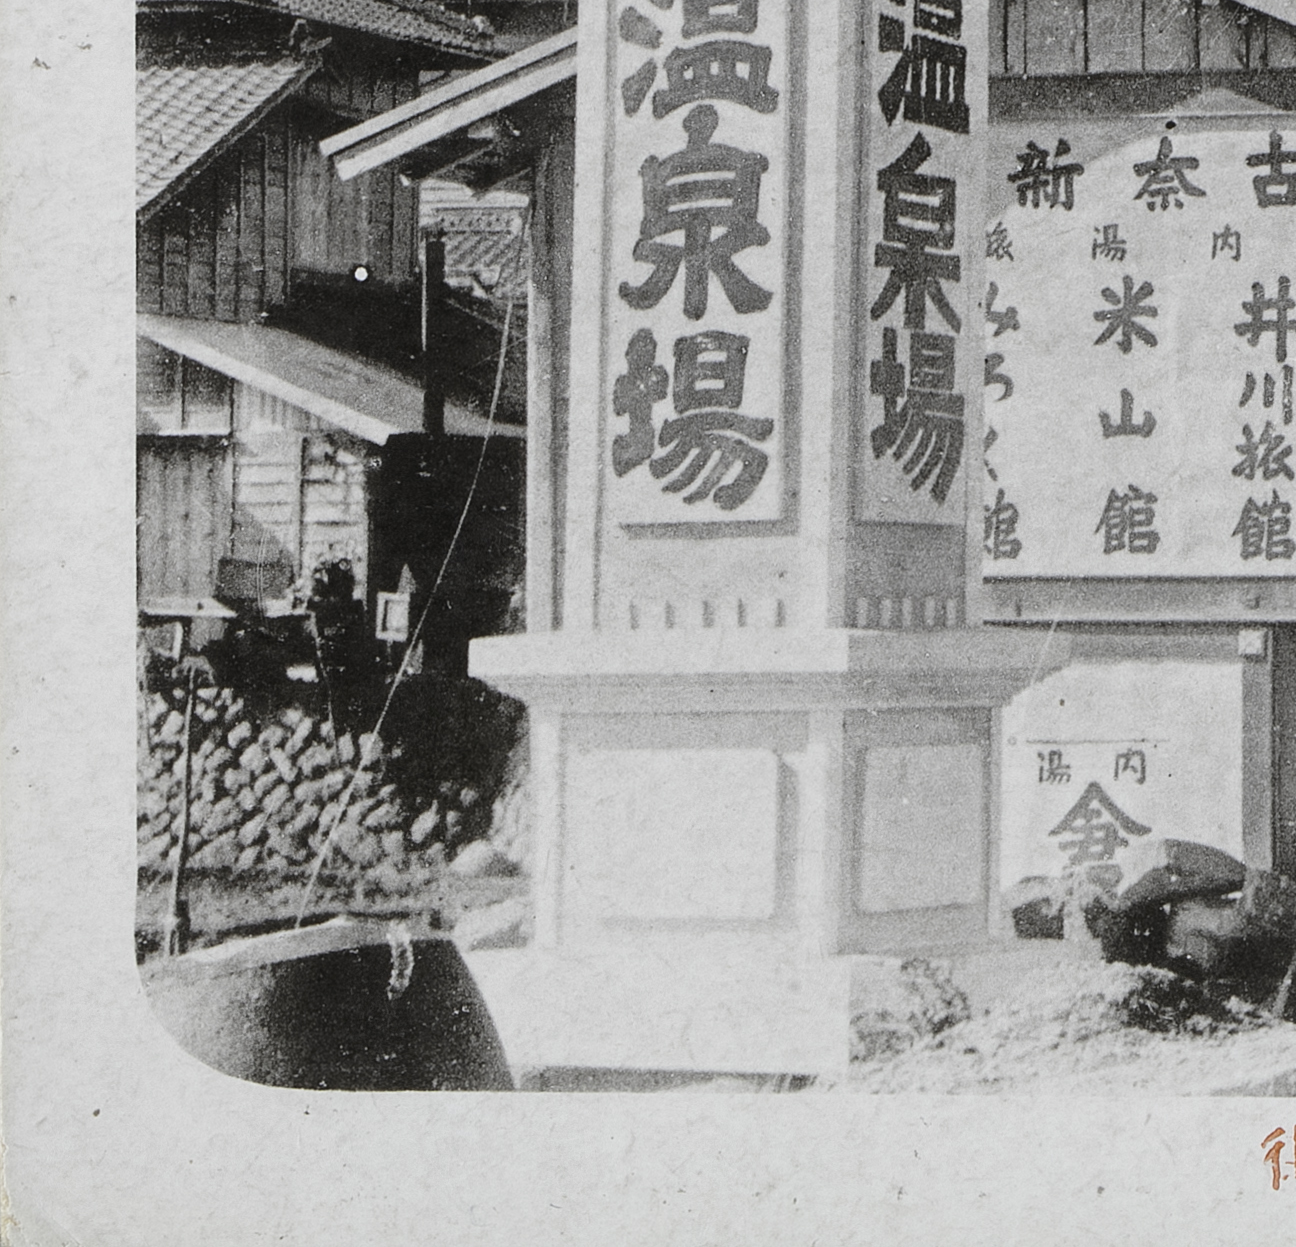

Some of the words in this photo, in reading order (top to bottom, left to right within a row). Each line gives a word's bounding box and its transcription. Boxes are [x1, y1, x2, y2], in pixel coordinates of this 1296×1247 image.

[1092, 273, 1161, 556] 米山館
[1036, 747, 1147, 786] 内湯
